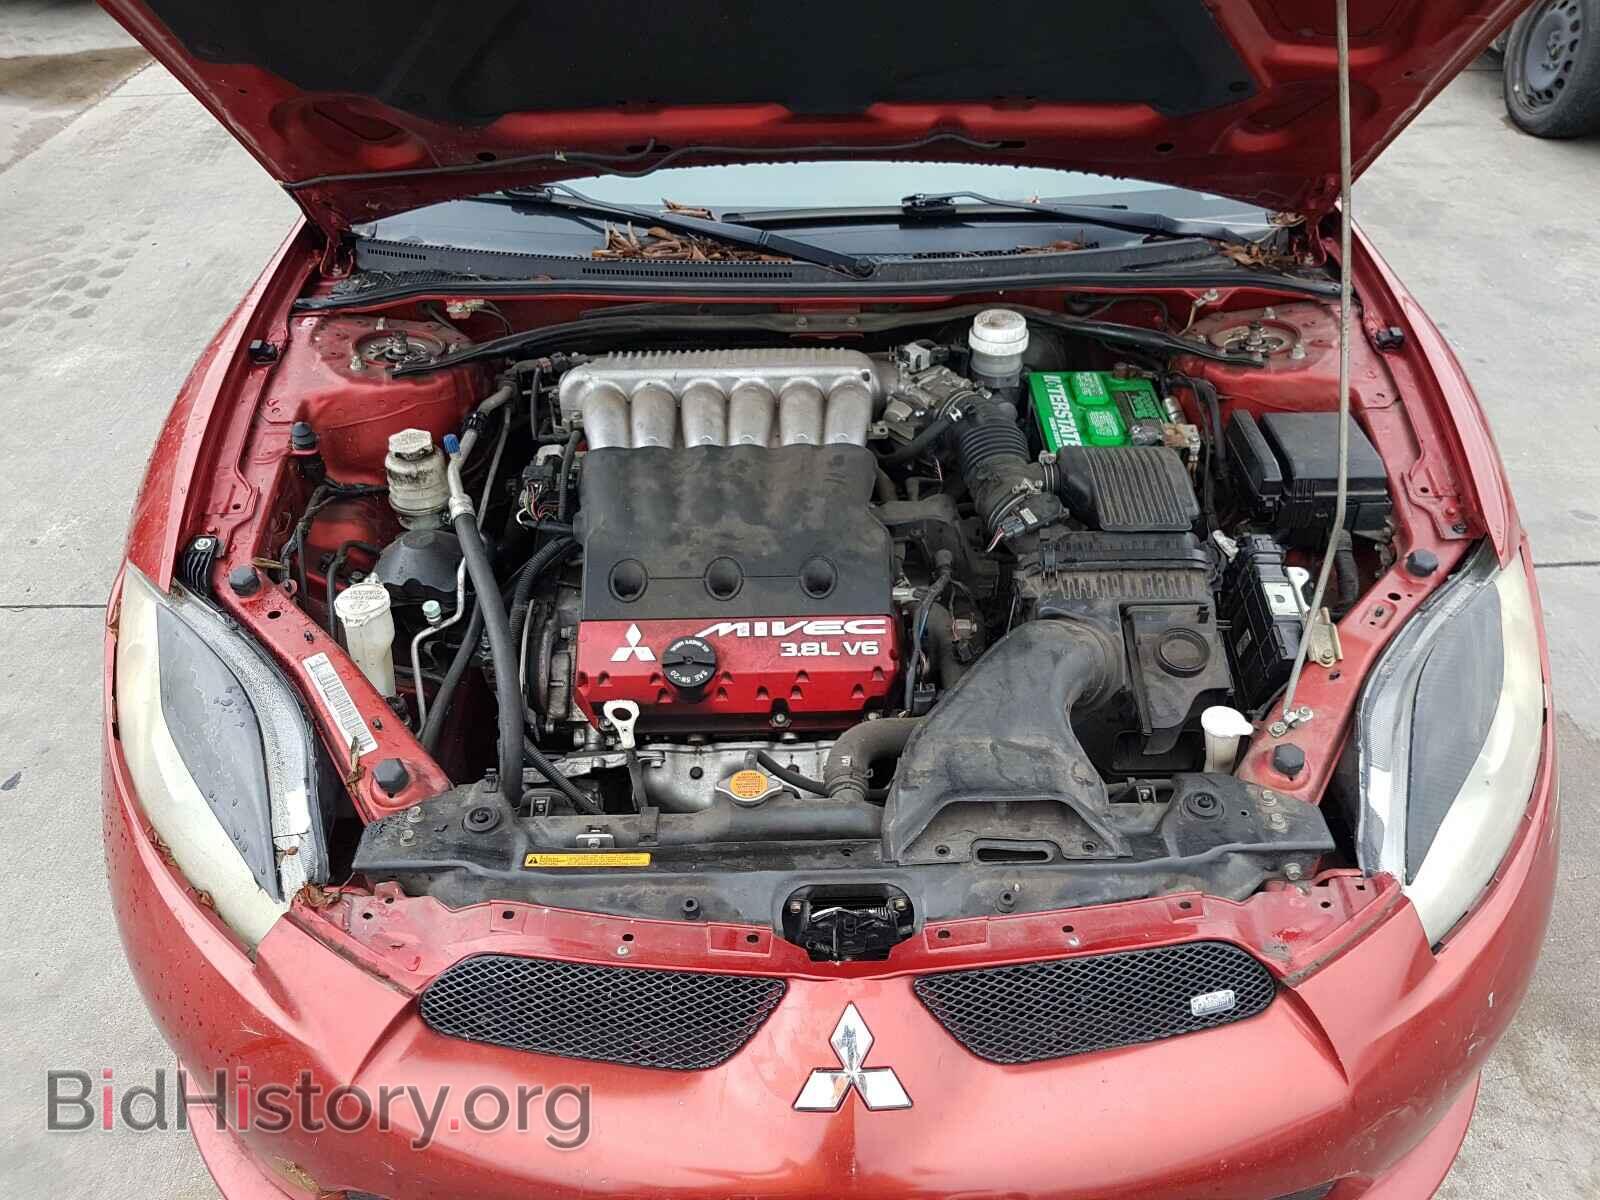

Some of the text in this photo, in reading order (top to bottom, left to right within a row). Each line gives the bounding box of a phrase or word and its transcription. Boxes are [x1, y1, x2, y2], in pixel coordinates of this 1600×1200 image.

[695, 619, 887, 637] MIVEC
[780, 641, 879, 656] 3.8L V6
[694, 670, 708, 682] SAE
